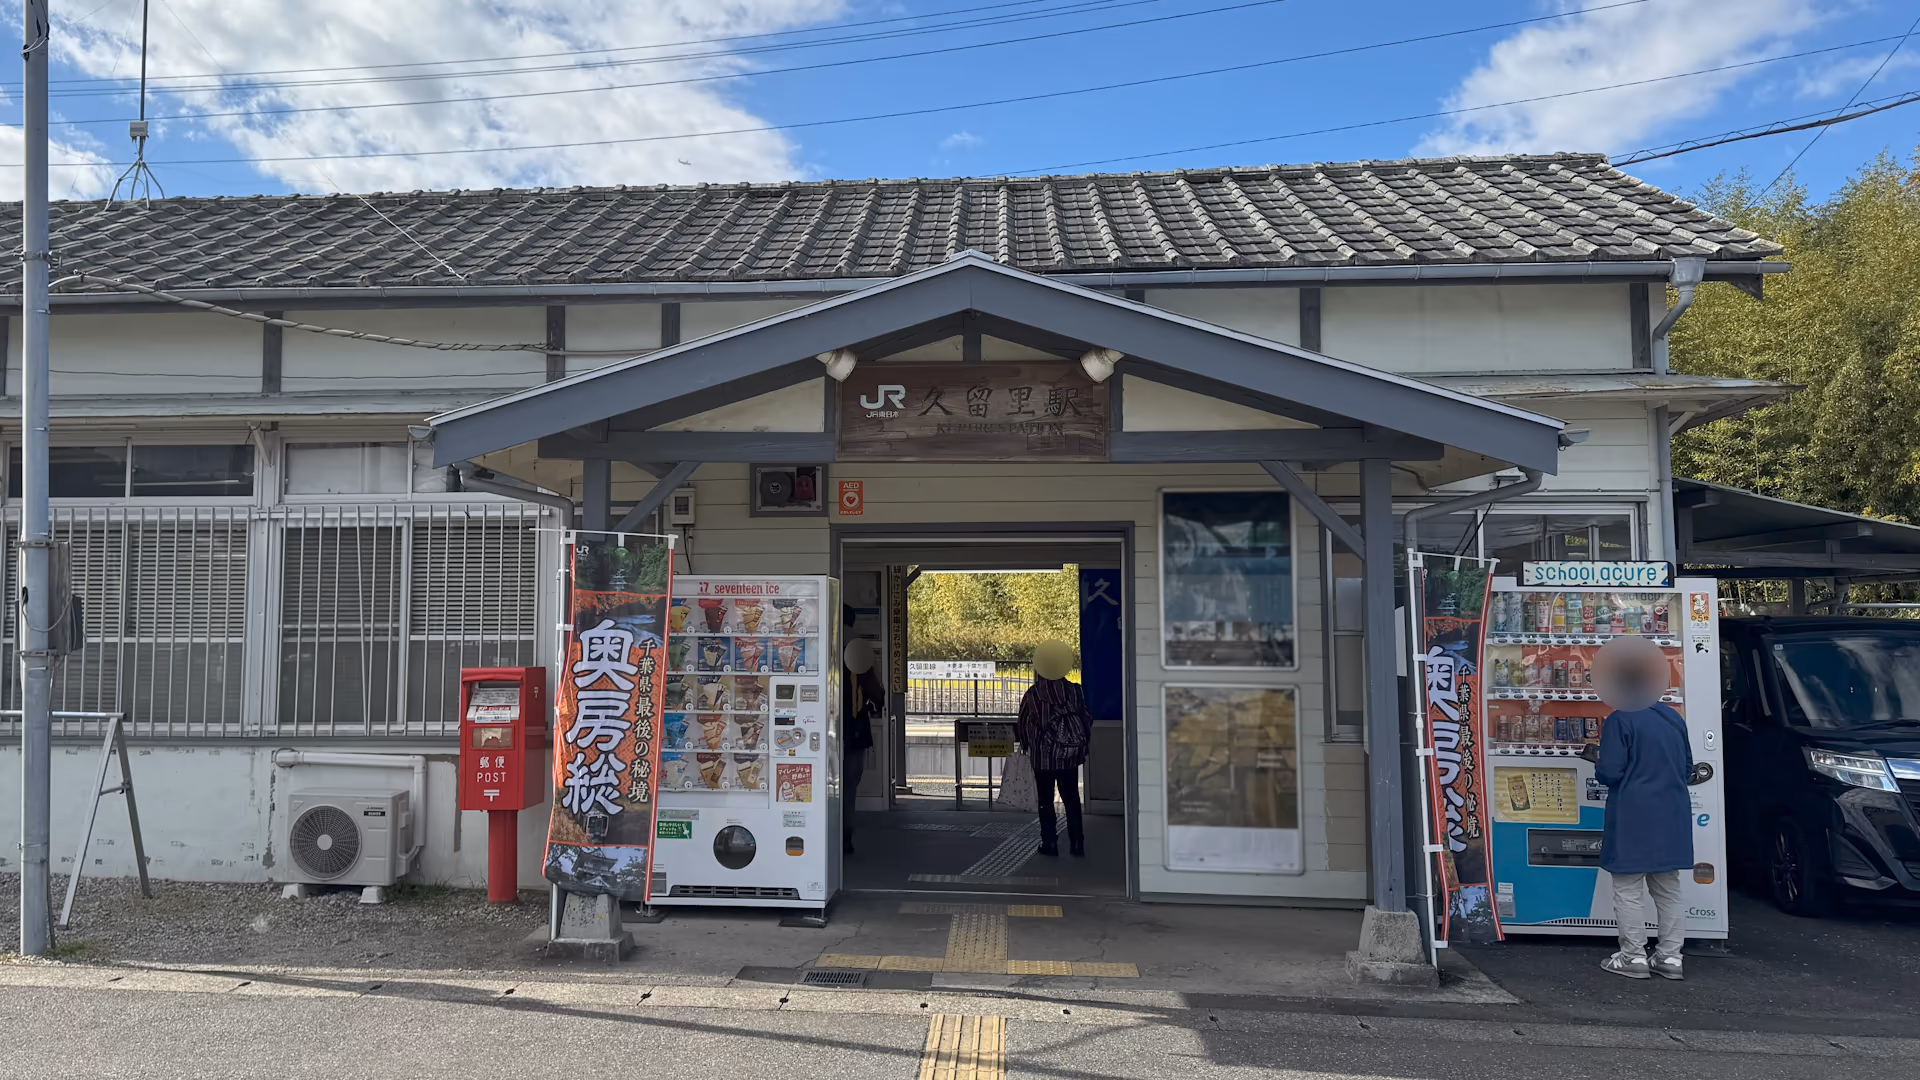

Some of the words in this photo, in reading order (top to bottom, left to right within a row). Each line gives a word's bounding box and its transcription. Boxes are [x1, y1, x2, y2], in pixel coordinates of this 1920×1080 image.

[860, 385, 905, 409] JR
[918, 385, 1083, 418] 久留里駅
[576, 544, 589, 555] JR
[1535, 566, 1595, 581] school
[1600, 566, 1657, 581] acure
[714, 584, 763, 594] seventeen
[766, 582, 780, 594] ice
[562, 619, 639, 816] 奥房総
[628, 638, 656, 803] 千葉県最後の秘境
[480, 756, 505, 769] 郵便
[477, 772, 507, 783] POST
